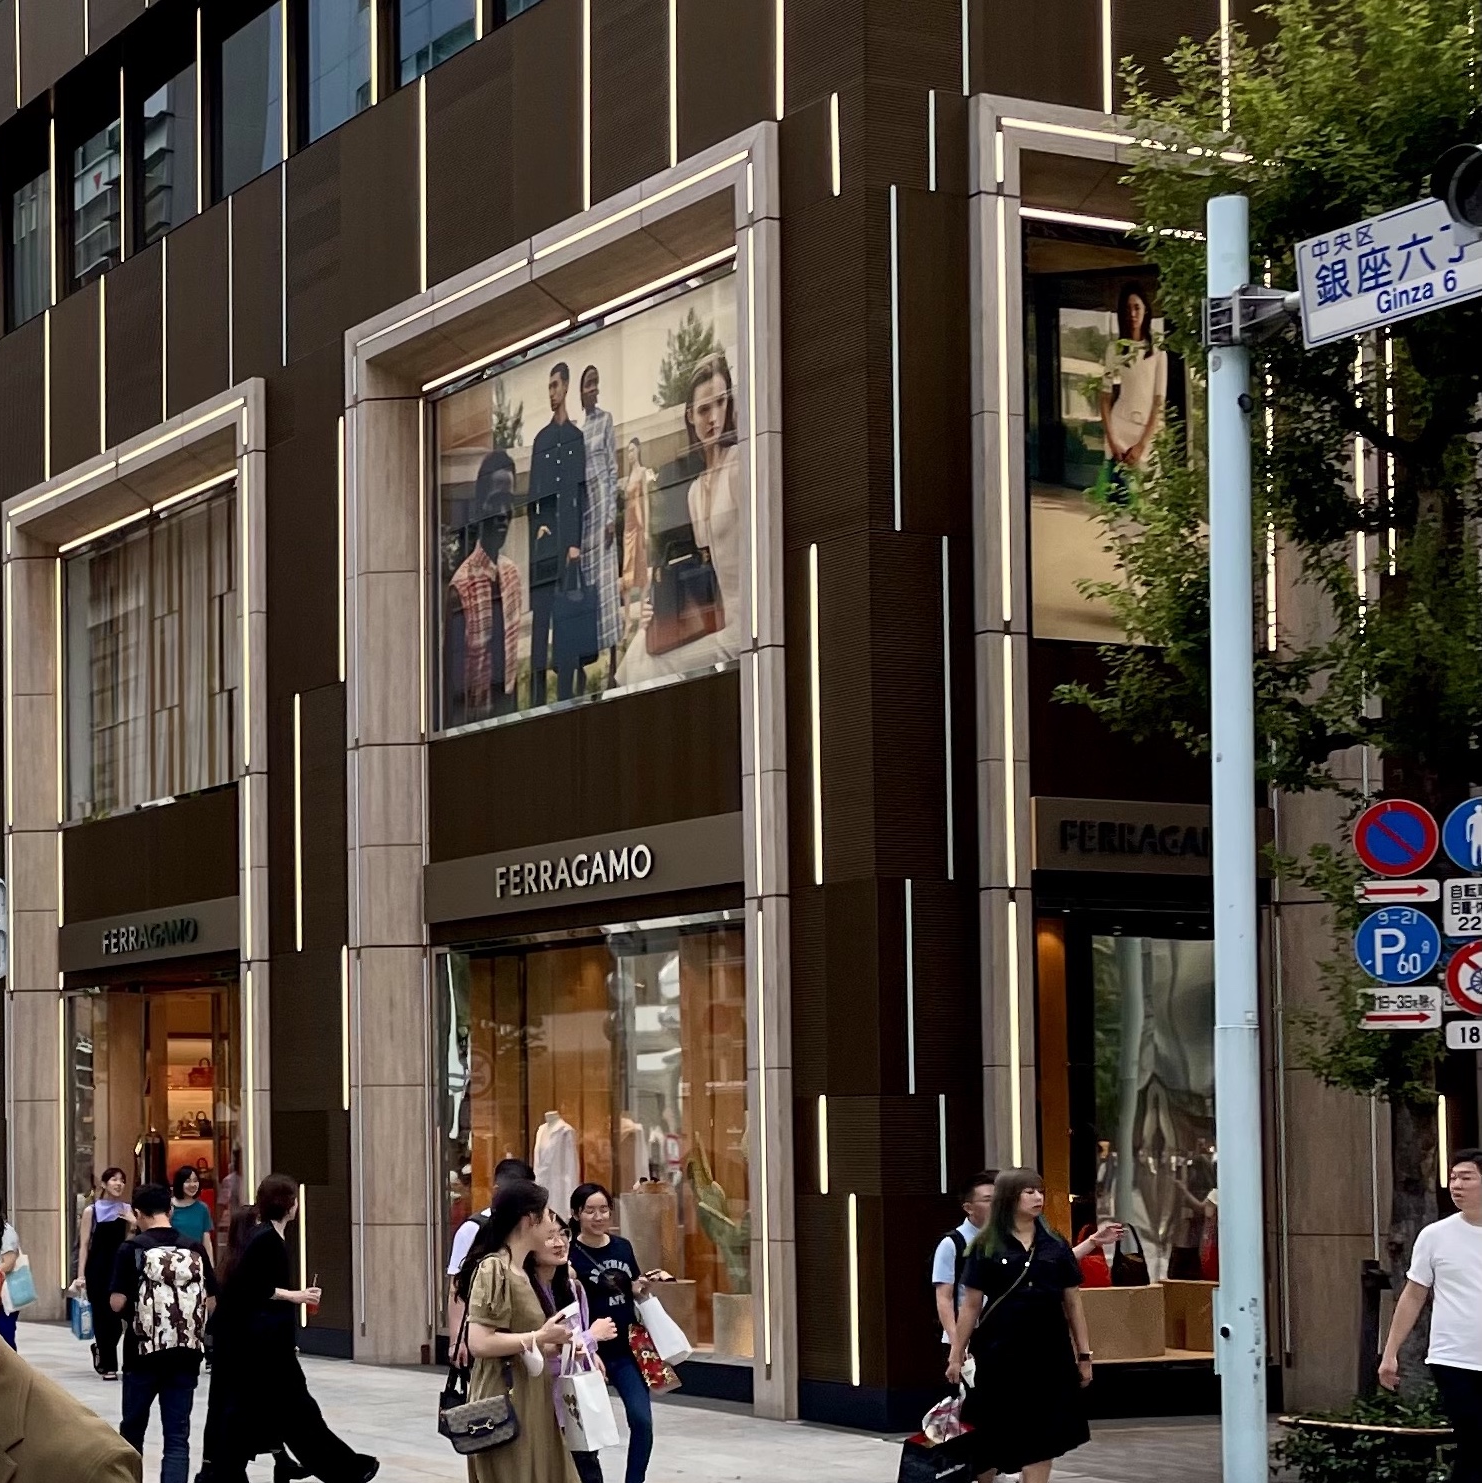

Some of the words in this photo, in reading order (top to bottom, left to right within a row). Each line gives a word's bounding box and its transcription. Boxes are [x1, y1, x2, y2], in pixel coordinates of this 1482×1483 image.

[1311, 223, 1375, 262] 中央区
[1376, 282, 1434, 314] Ginza
[1443, 269, 1458, 293] 6
[495, 843, 652, 898] FERRAGAMO
[101, 917, 198, 955] FERRAGAMO
[1377, 911, 1418, 925] 9-21
[1374, 928, 1407, 976] P
[1397, 953, 1422, 975] 60
[1460, 1026, 1481, 1044] 18
